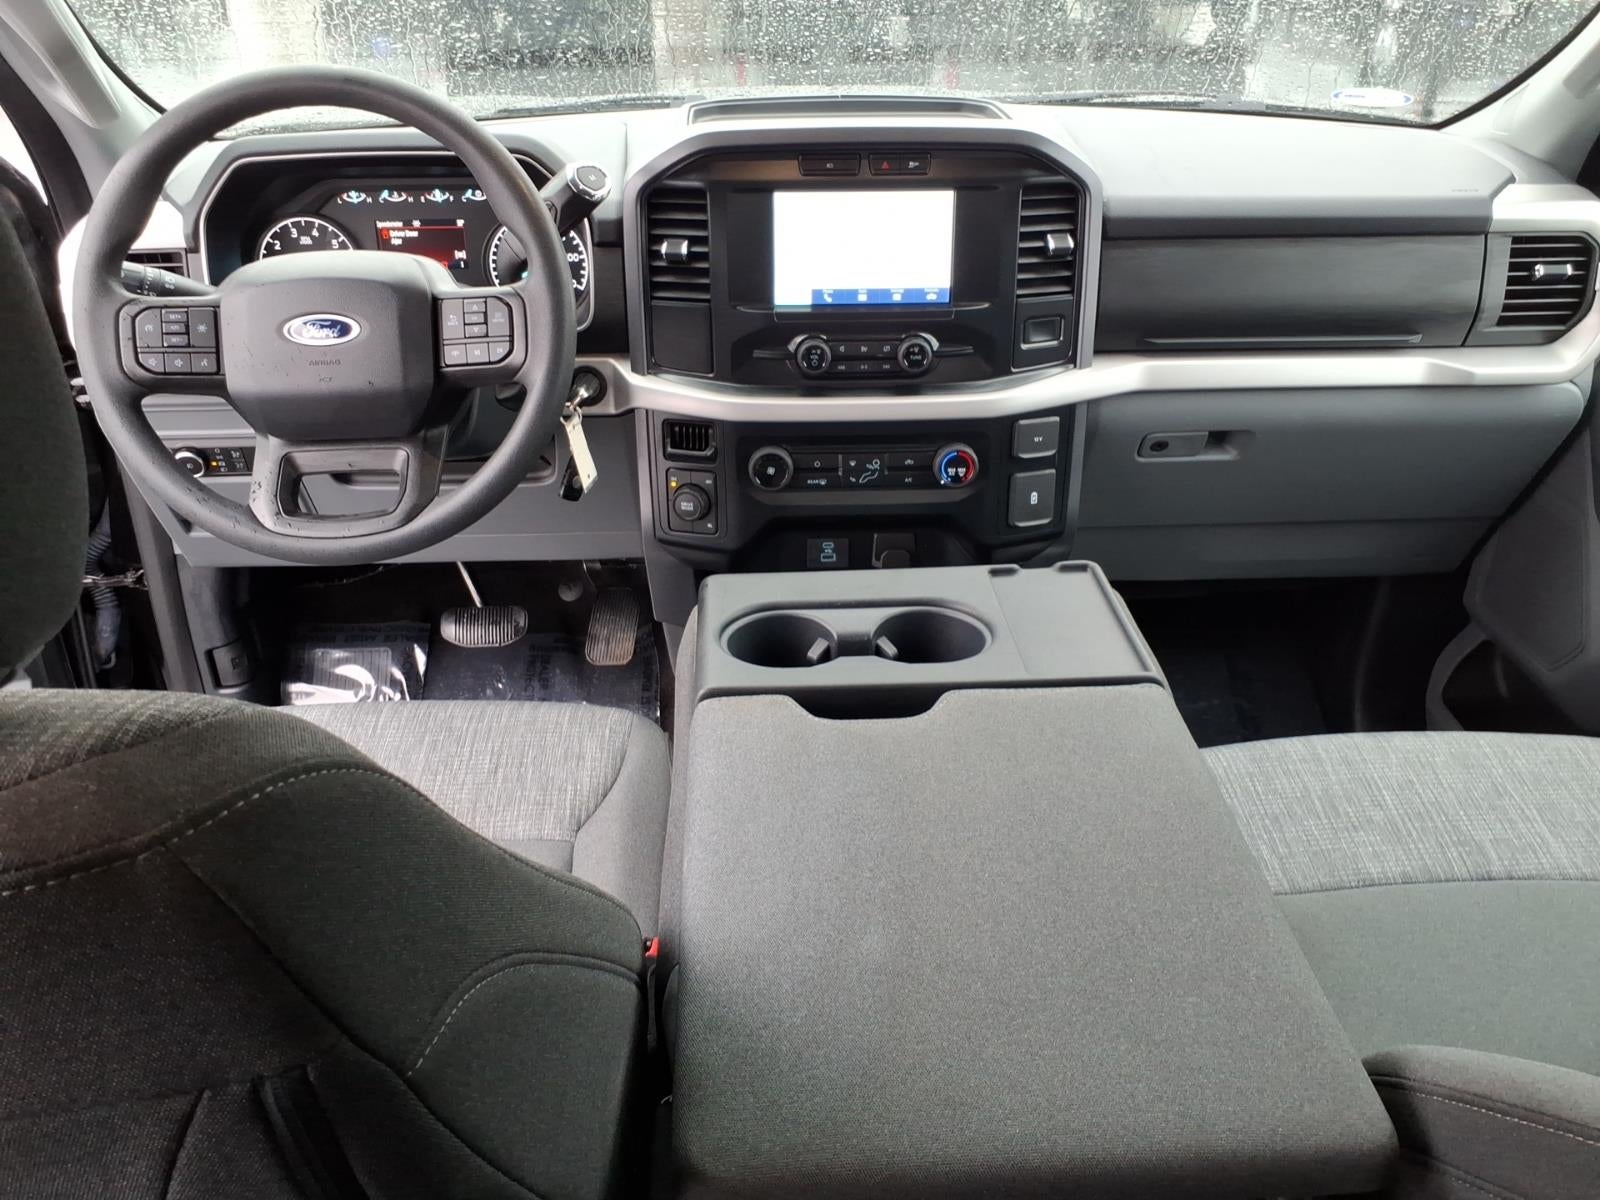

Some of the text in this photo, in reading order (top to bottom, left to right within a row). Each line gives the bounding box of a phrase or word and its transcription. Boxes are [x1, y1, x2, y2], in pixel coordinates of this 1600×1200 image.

[290, 228, 298, 238] 3
[311, 228, 320, 238] 4
[273, 239, 282, 250] 2
[331, 239, 339, 249] 5
[303, 320, 341, 338] Ford
[308, 359, 341, 367] AIRBAG
